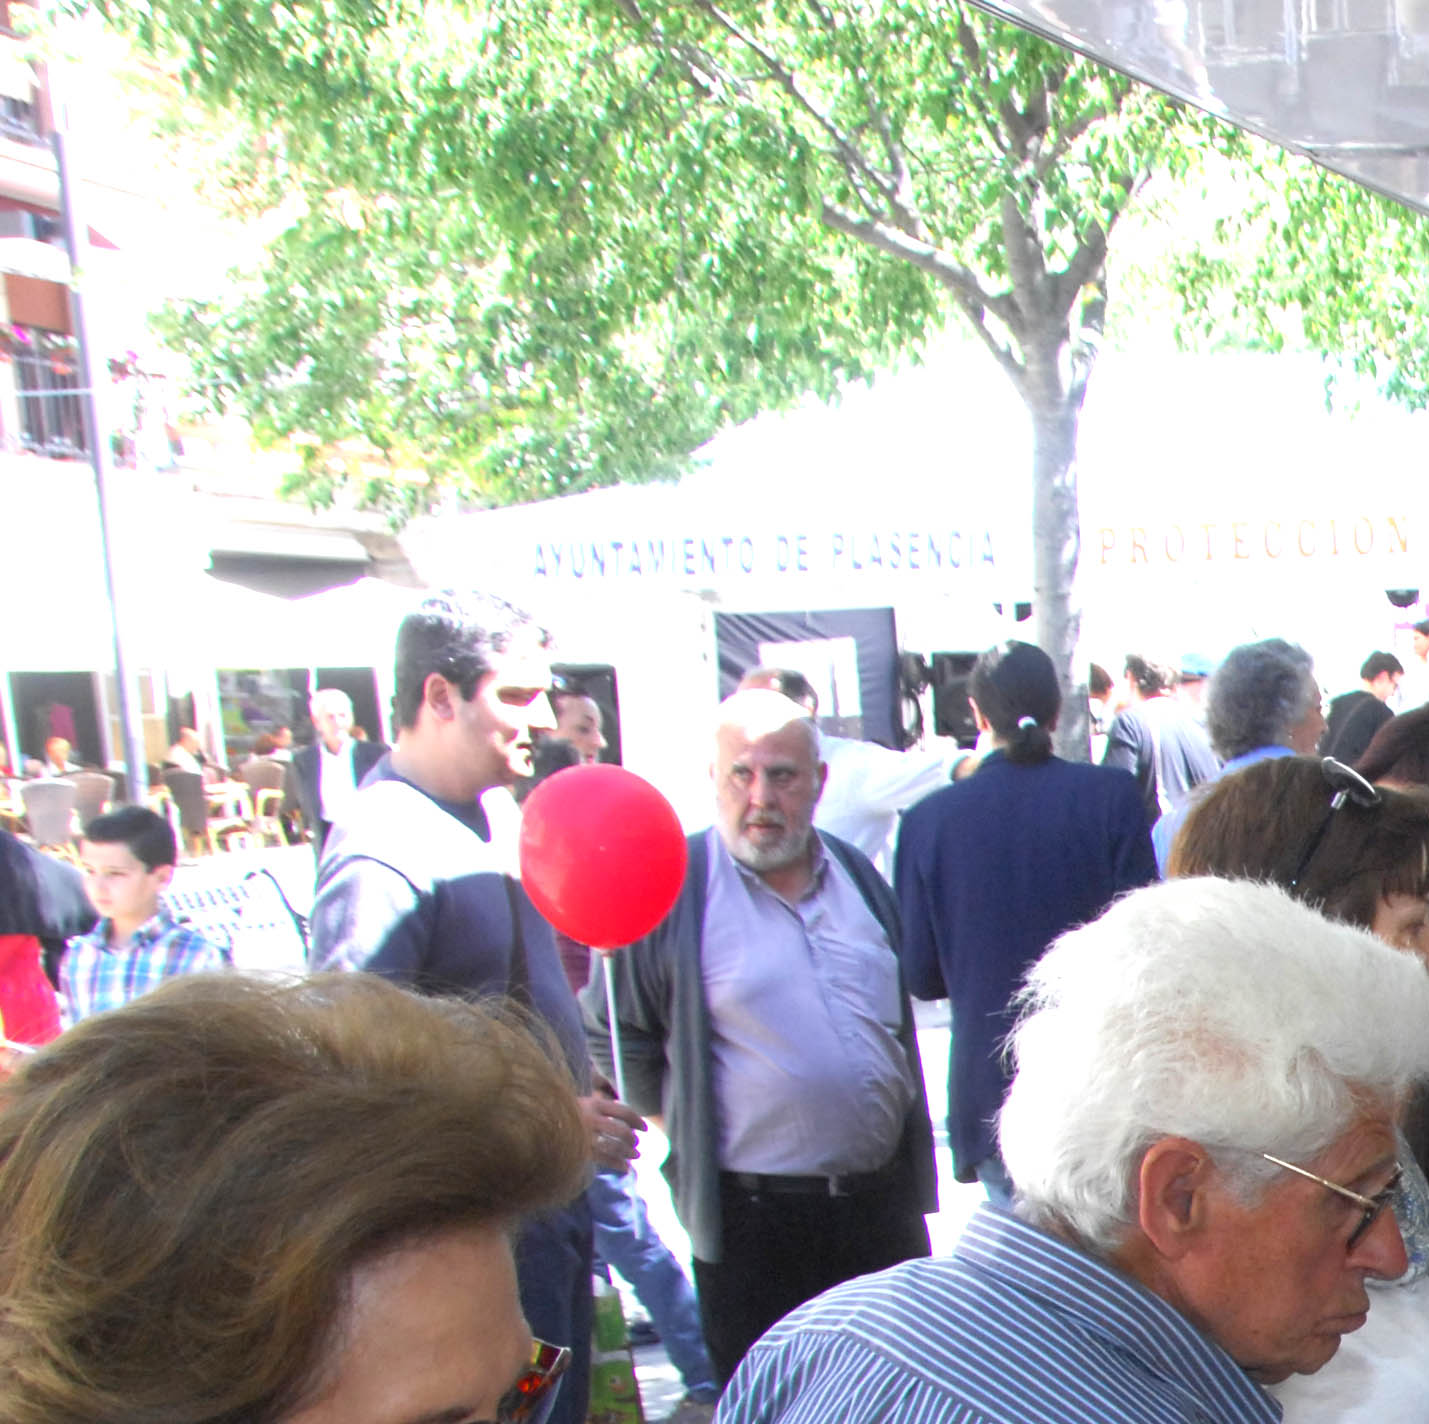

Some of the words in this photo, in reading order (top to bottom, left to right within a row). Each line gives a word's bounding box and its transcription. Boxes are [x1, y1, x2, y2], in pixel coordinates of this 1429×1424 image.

[533, 537, 754, 579] AYUNTAMIENTO
[777, 535, 809, 572] DE
[833, 531, 997, 572] PLASENCIA
